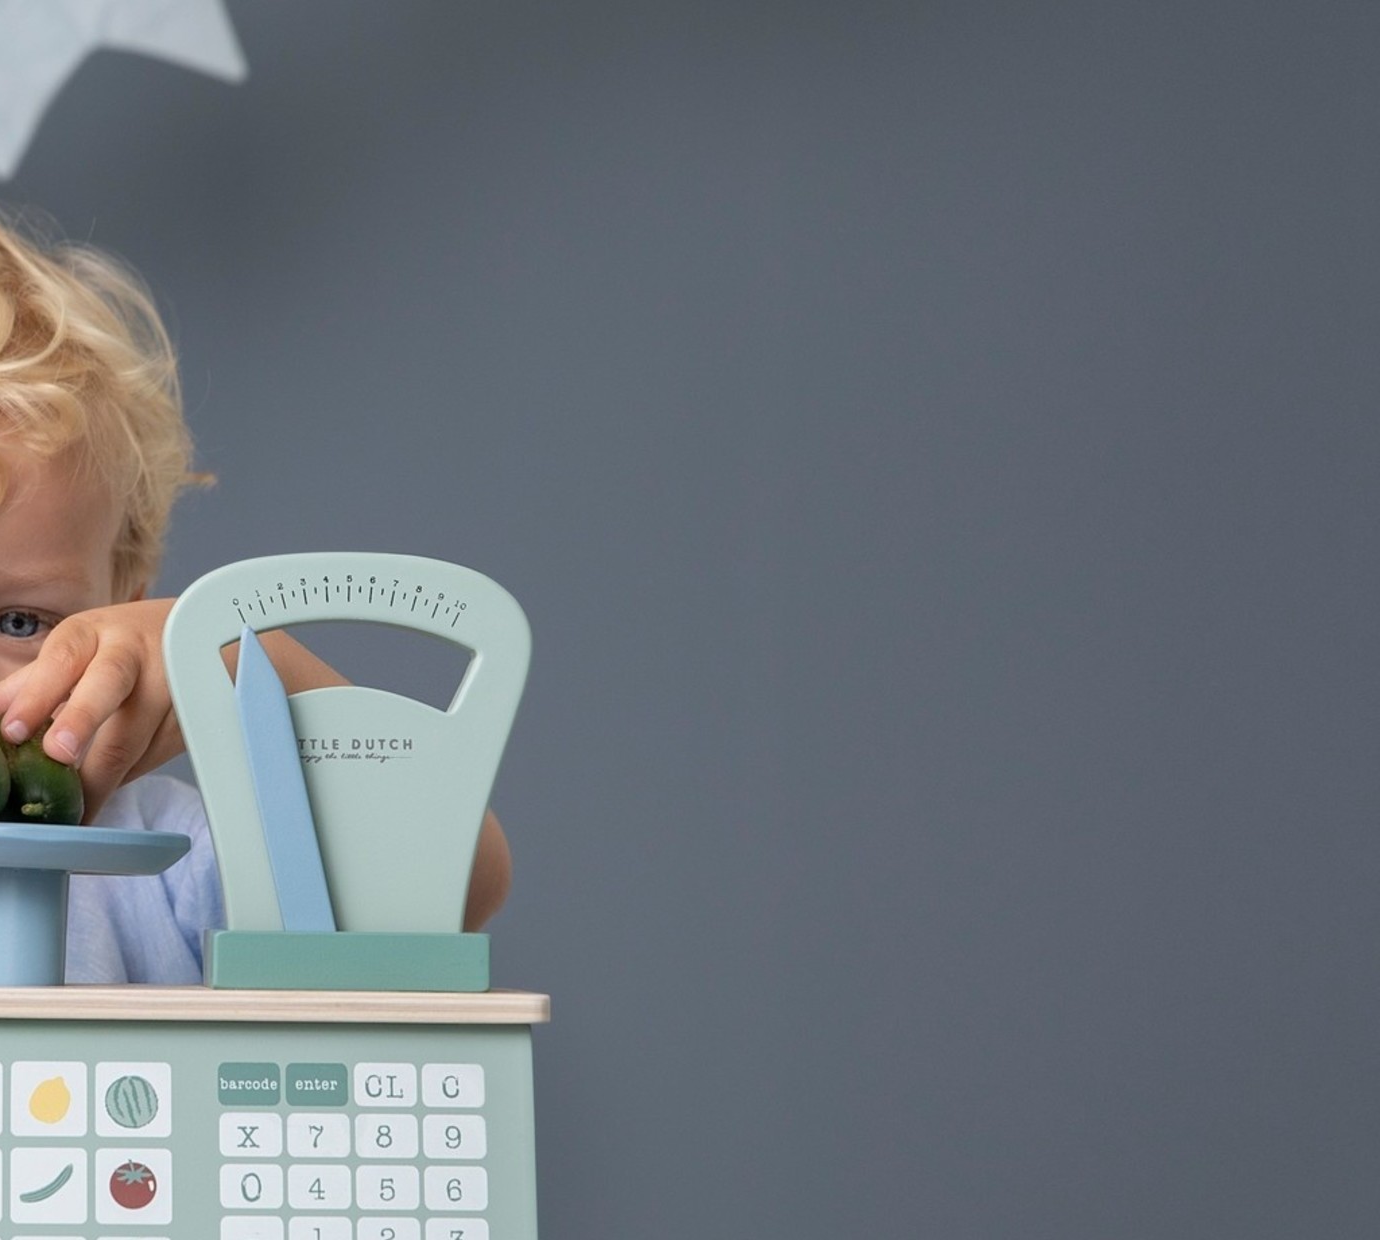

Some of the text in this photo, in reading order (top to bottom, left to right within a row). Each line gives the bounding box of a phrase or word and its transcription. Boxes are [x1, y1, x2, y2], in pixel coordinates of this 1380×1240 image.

[232, 598, 240, 606] 0
[299, 578, 307, 586] 3
[346, 575, 353, 583] 5
[370, 576, 376, 584] 6
[393, 579, 400, 587] 7
[415, 585, 423, 593] 8
[437, 592, 445, 601] 9
[454, 600, 467, 611] 10
[297, 739, 413, 750] TTLE DUTCH
[220, 1074, 460, 1099] barcode enter CL C
[237, 1125, 462, 1149] X 7 8 9
[309, 1178, 325, 1200] 4
[380, 1178, 396, 1201] 5
[446, 1178, 462, 1201] 6
